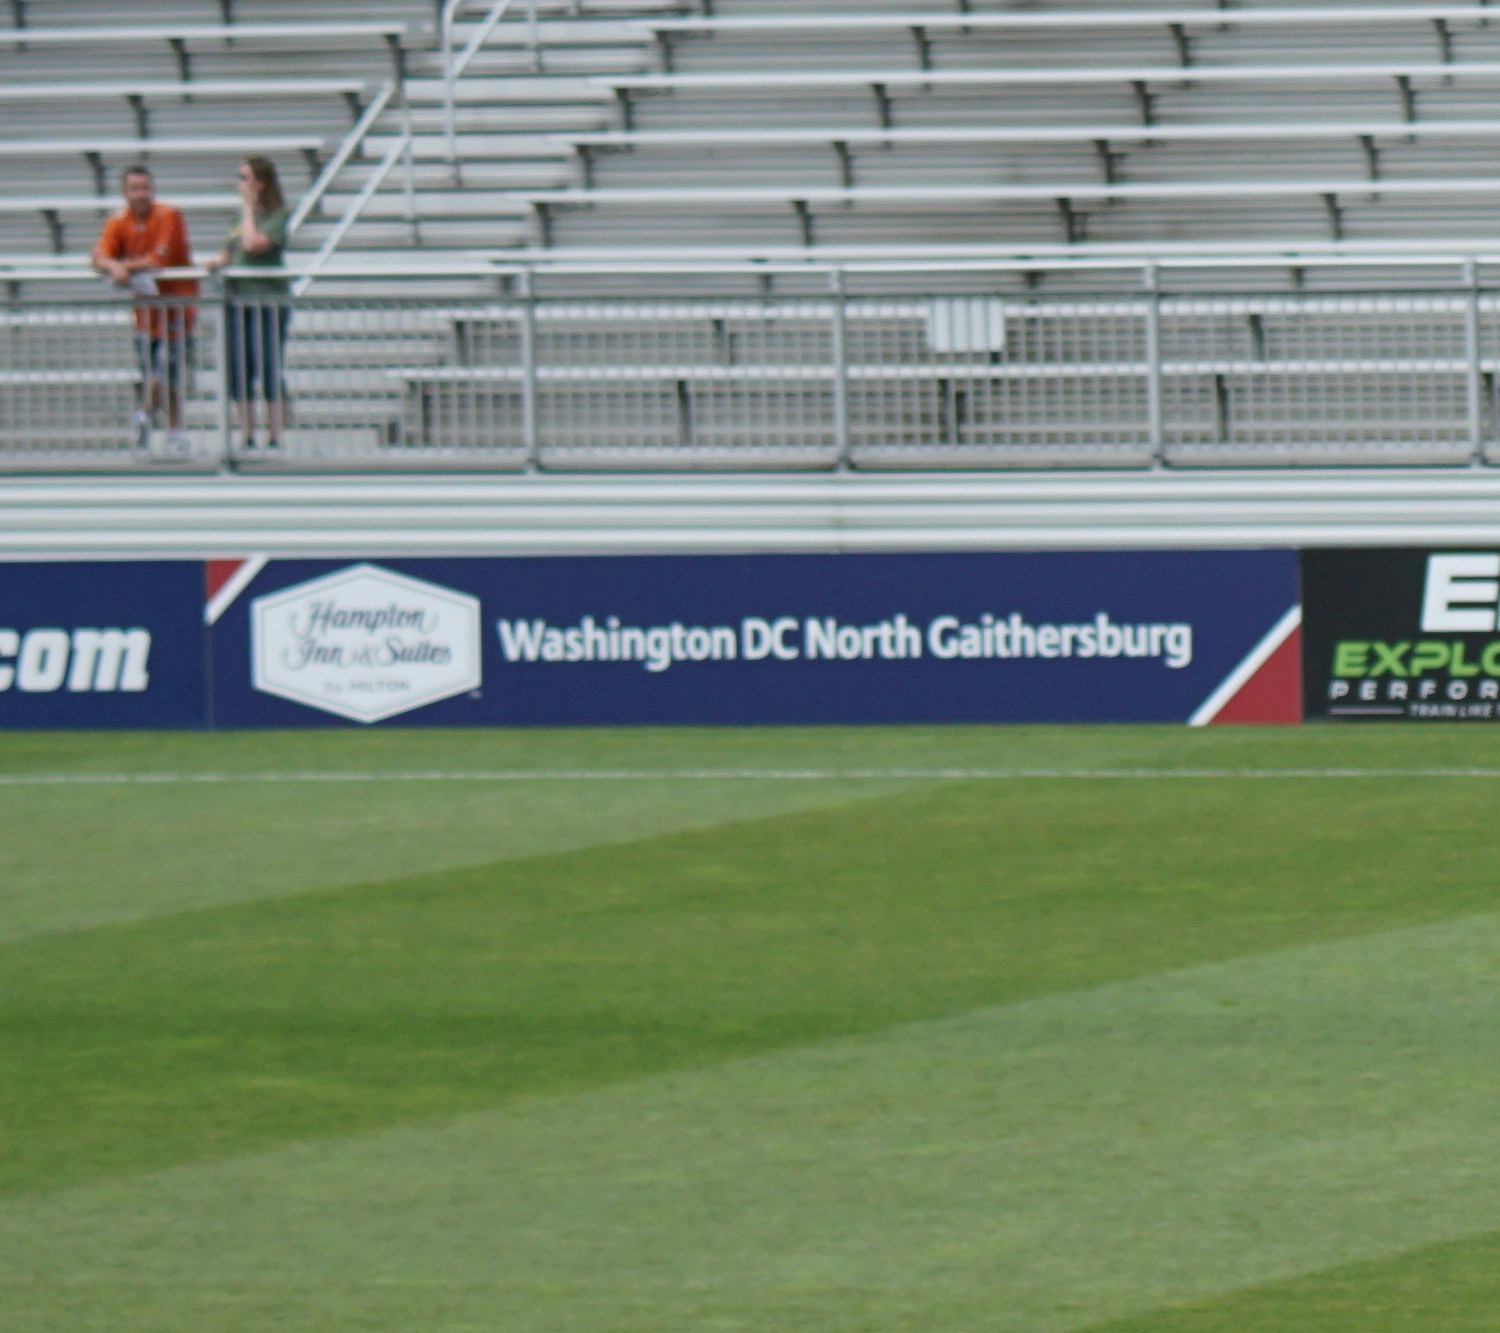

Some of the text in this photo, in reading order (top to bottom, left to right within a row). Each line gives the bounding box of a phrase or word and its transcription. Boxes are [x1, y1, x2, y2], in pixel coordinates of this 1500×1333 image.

[289, 600, 438, 641] Hampton
[284, 638, 346, 670] Inn
[377, 635, 452, 667] Suites
[498, 612, 1192, 672] Washington DC North Gaithersburg
[349, 679, 411, 693] HILTON
